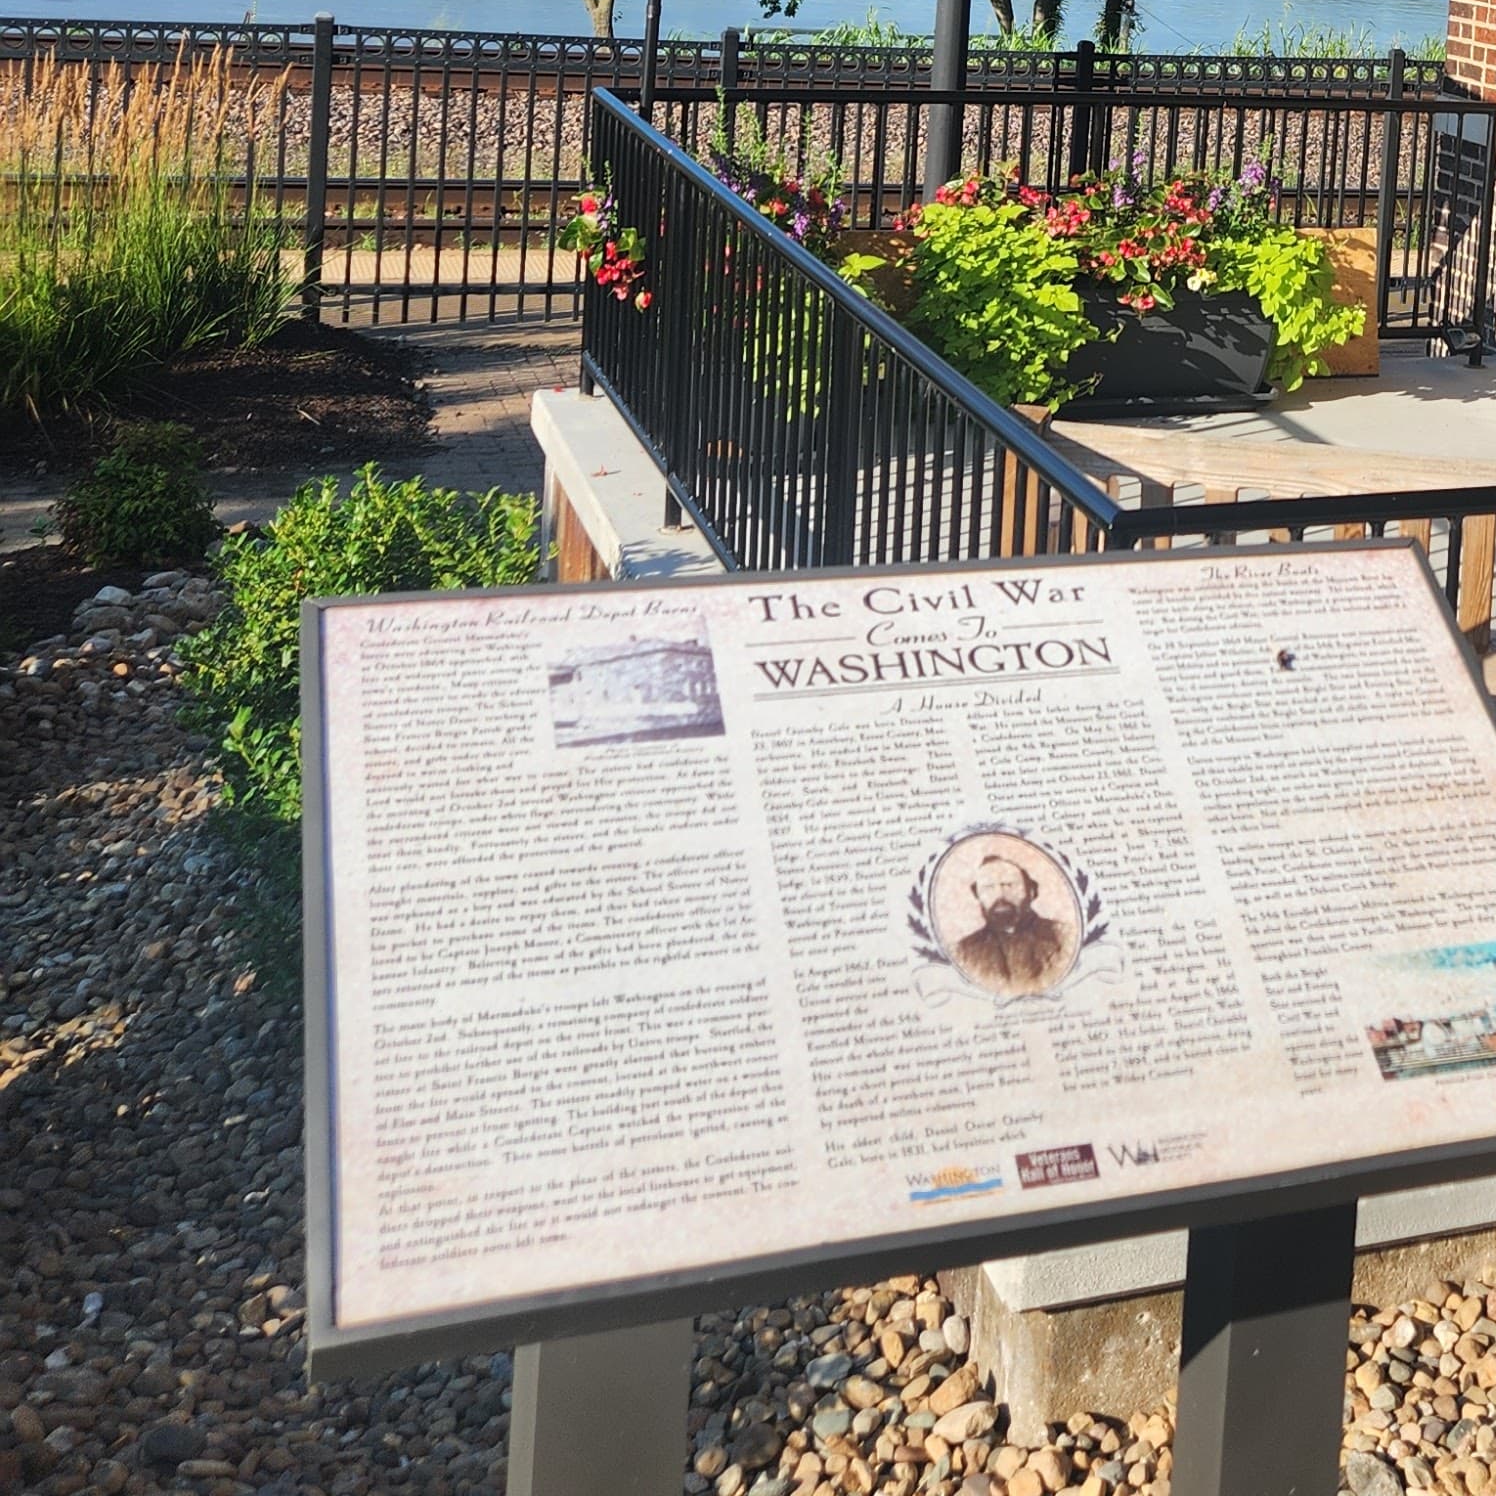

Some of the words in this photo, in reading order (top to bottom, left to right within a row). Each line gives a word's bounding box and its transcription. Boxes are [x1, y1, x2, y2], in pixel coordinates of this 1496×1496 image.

[748, 593, 842, 623] The
[863, 584, 978, 615] Civil
[993, 578, 1085, 606] War
[366, 616, 479, 635] Washington
[485, 608, 572, 628] Railroad
[865, 620, 949, 647] Comes
[956, 615, 998, 642] To
[753, 636, 1114, 690] WASHINGTON
[880, 696, 903, 715] A
[910, 694, 968, 714] House
[974, 687, 1043, 710] Divided
